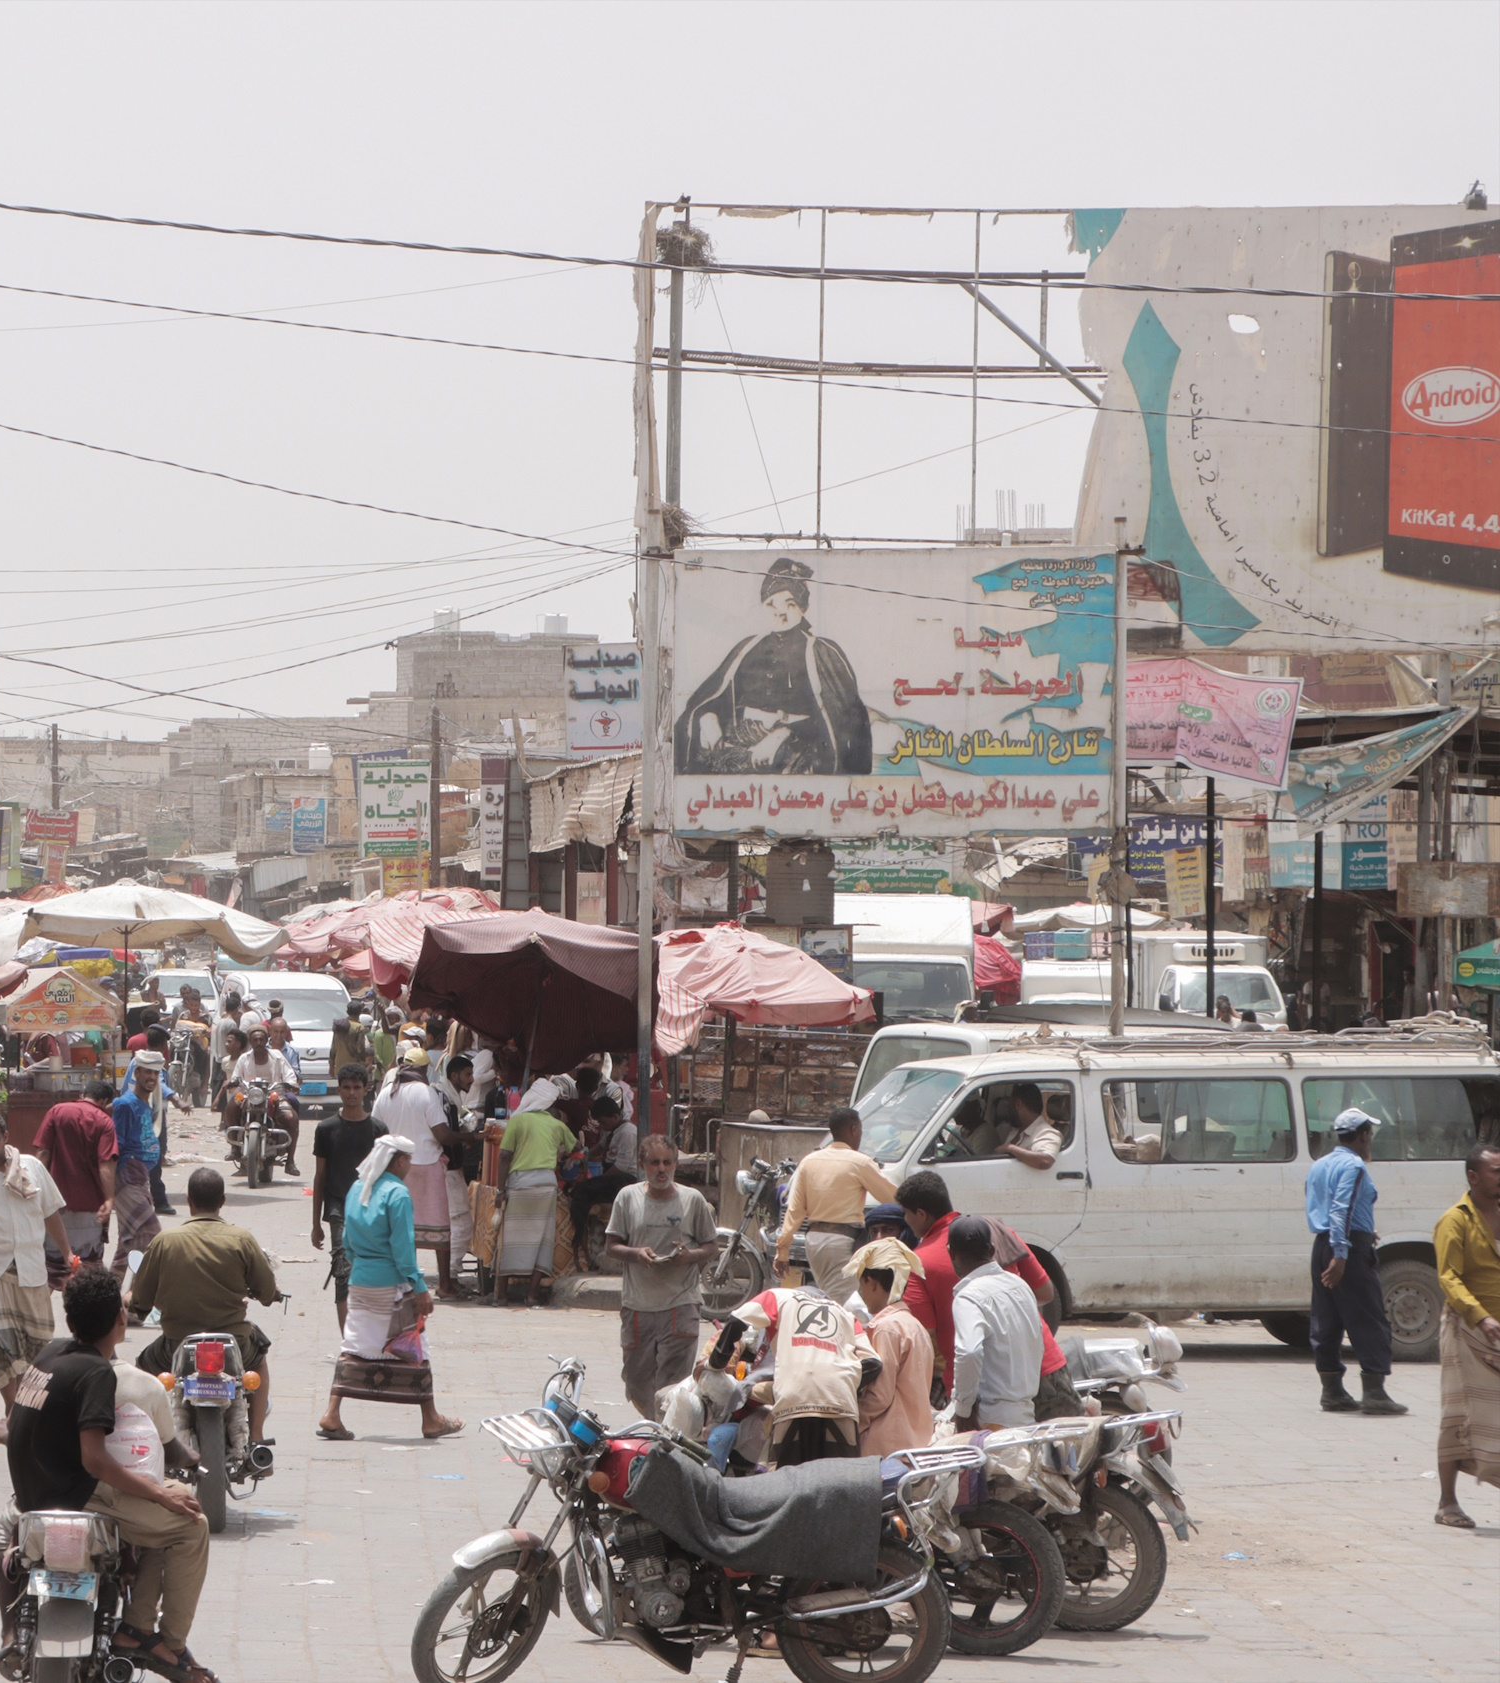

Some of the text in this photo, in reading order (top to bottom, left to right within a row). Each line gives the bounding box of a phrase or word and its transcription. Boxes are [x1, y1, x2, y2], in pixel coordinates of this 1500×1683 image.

[1408, 380, 1496, 417] Android
[1193, 449, 1217, 486] 3.2
[1206, 492, 1238, 542] أمامية
[1401, 508, 1456, 528] KitKat
[1011, 577, 1028, 590] لحج
[1041, 575, 1074, 589] الحوطة
[1076, 574, 1106, 589] مديرية
[1235, 546, 1280, 597] بكاميرا
[1055, 592, 1085, 605] المجلس
[953, 626, 1023, 655] مدينة
[567, 647, 638, 676] صيدلية
[568, 678, 639, 705] الحوطة
[893, 672, 964, 706] لحج
[978, 668, 1083, 702] الحوطة
[887, 726, 1100, 765] شارع السلطان الثائر
[363, 768, 428, 788] صيدلية
[364, 801, 428, 822] الحياة
[686, 782, 764, 824] العبدلي
[767, 784, 825, 817] محسن
[829, 782, 869, 824] علي
[872, 783, 899, 819] بن
[902, 780, 947, 816] فضل
[1061, 782, 1100, 823] علي
[1135, 819, 1178, 846] قرقور
[1180, 820, 1197, 845] بن
